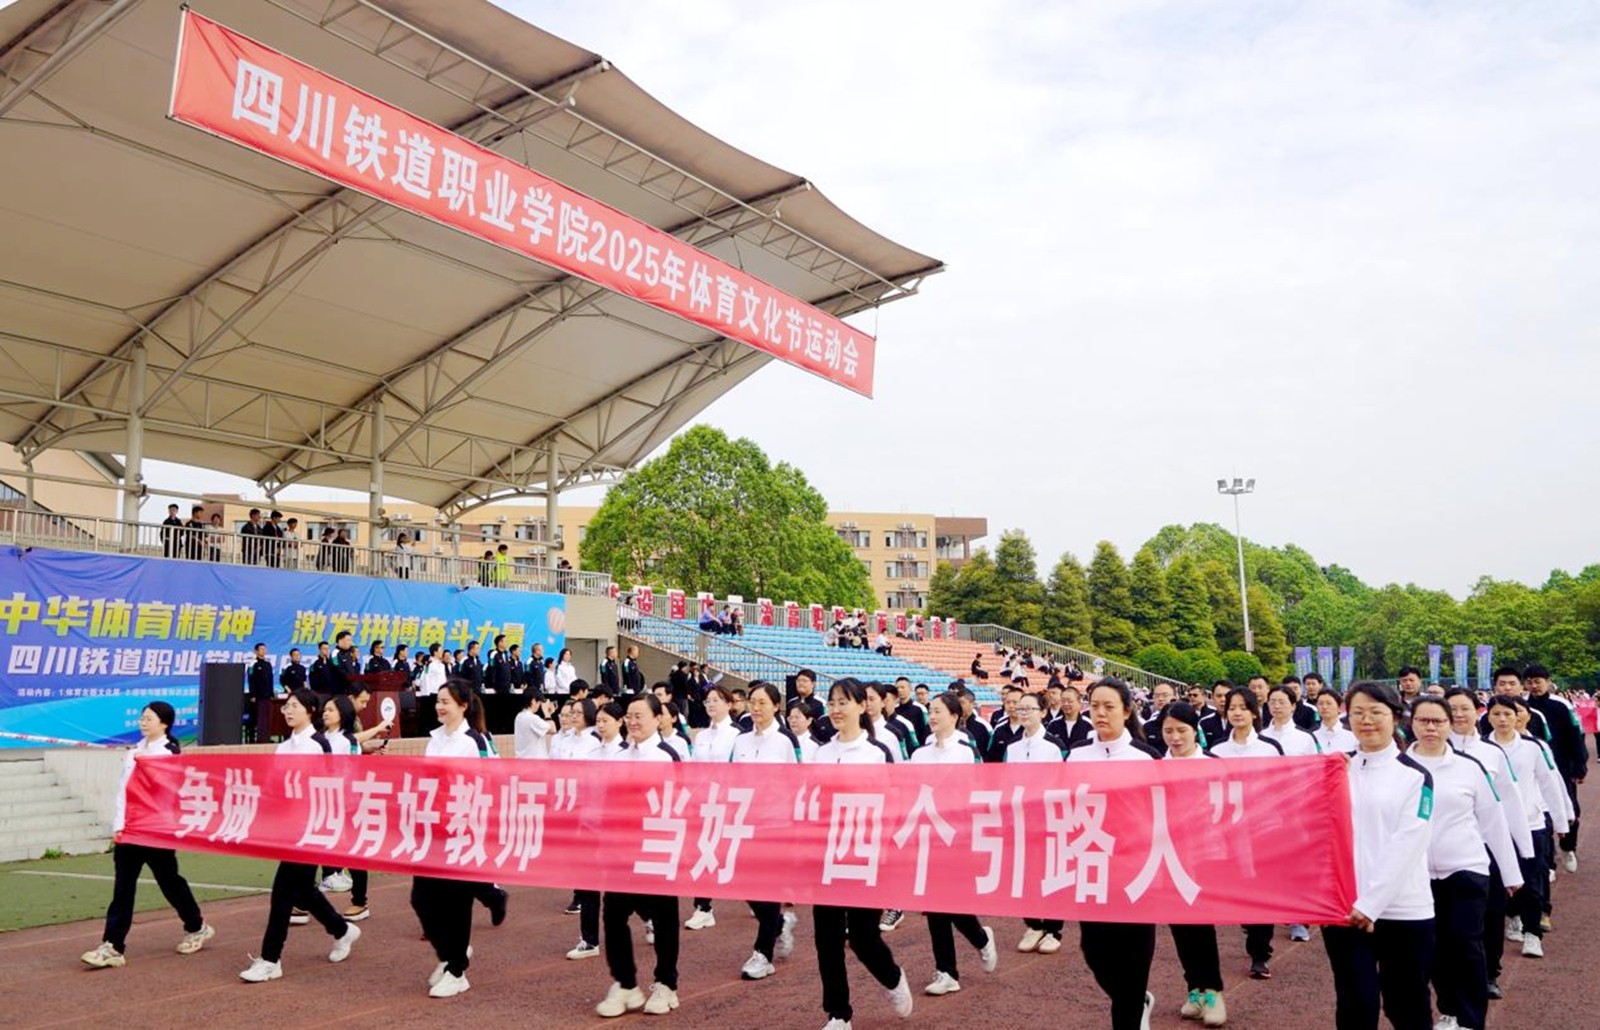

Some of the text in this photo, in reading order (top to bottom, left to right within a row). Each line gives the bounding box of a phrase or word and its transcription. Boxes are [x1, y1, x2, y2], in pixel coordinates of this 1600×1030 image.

[231, 58, 859, 379] 四川铁道职业学院2025年体育文化节运动会
[0, 592, 256, 643] 中华体育精神
